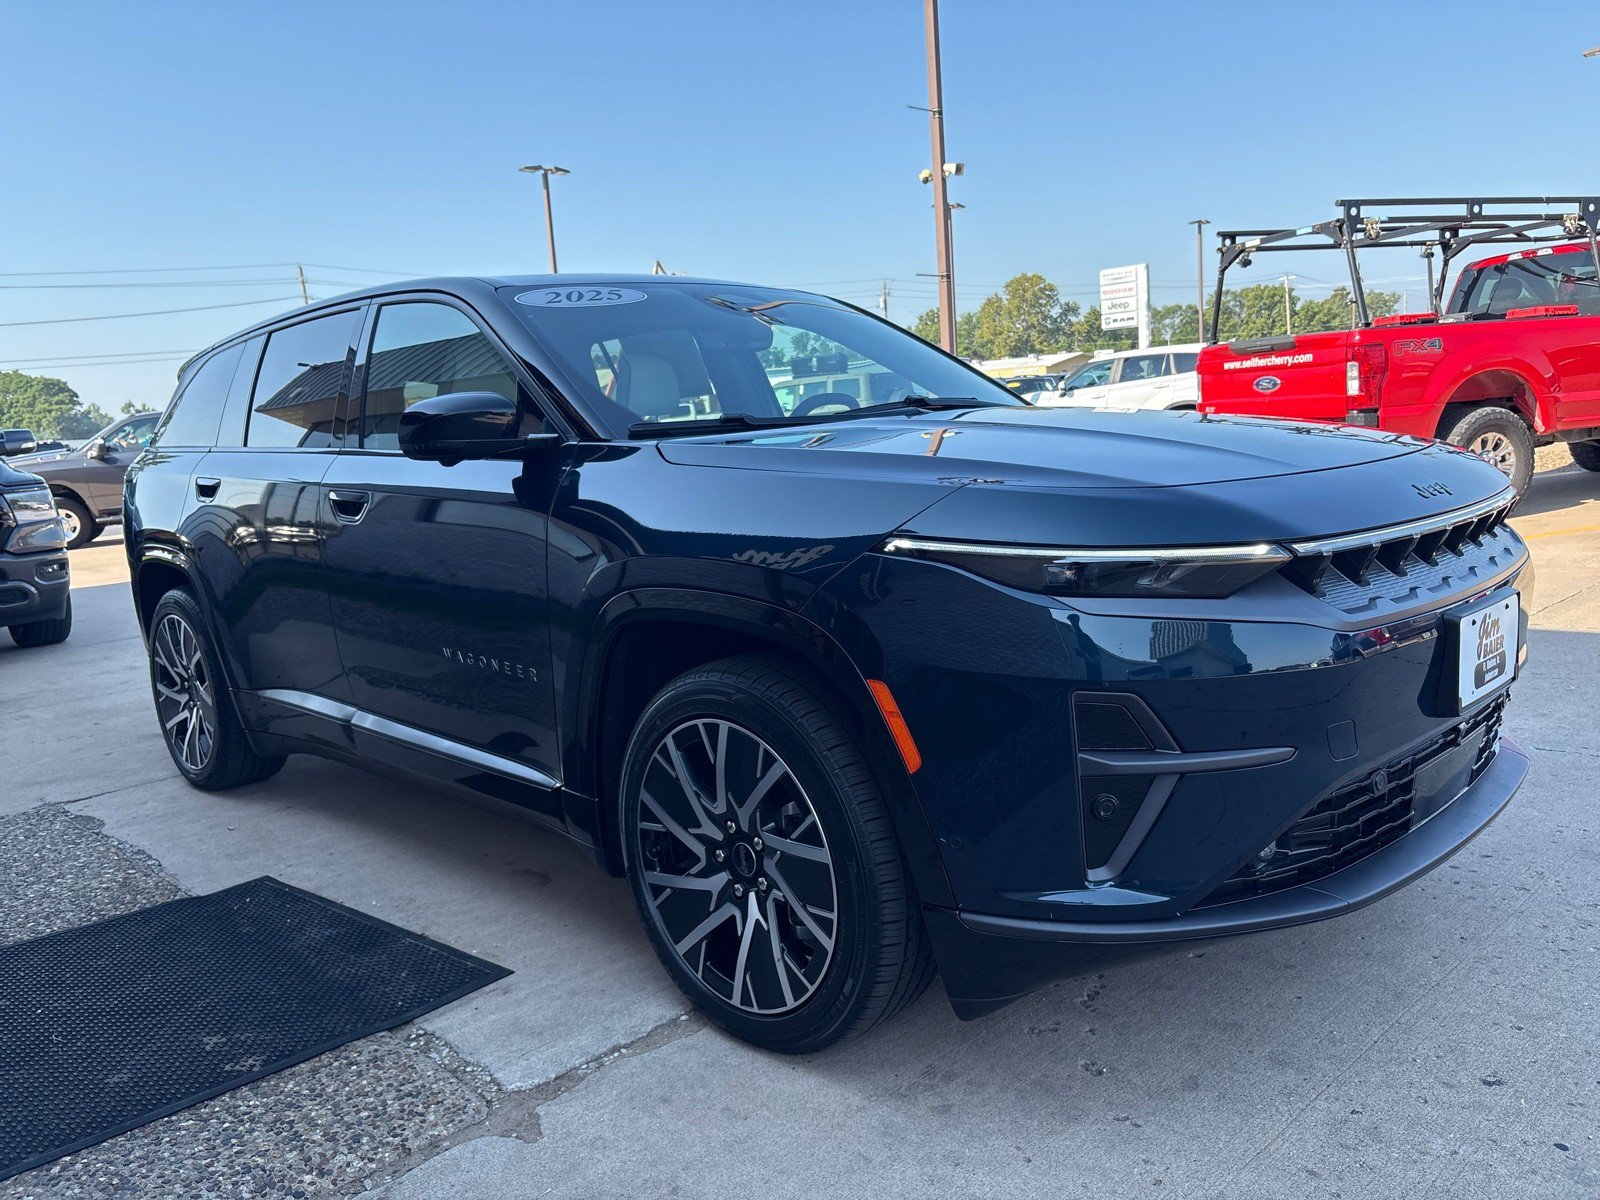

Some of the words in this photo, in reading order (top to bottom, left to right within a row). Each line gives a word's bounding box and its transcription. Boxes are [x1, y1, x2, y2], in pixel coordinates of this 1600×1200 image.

[544, 289, 623, 305] 2025
[1102, 287, 1134, 296] DODGE
[1107, 301, 1130, 311] Jeep
[1393, 337, 1443, 356] FX4
[1223, 353, 1314, 370] www.seithercherry.com
[1476, 612, 1501, 660] Jim
[1482, 633, 1505, 659] BAIER
[442, 647, 538, 682] WAGONEER
